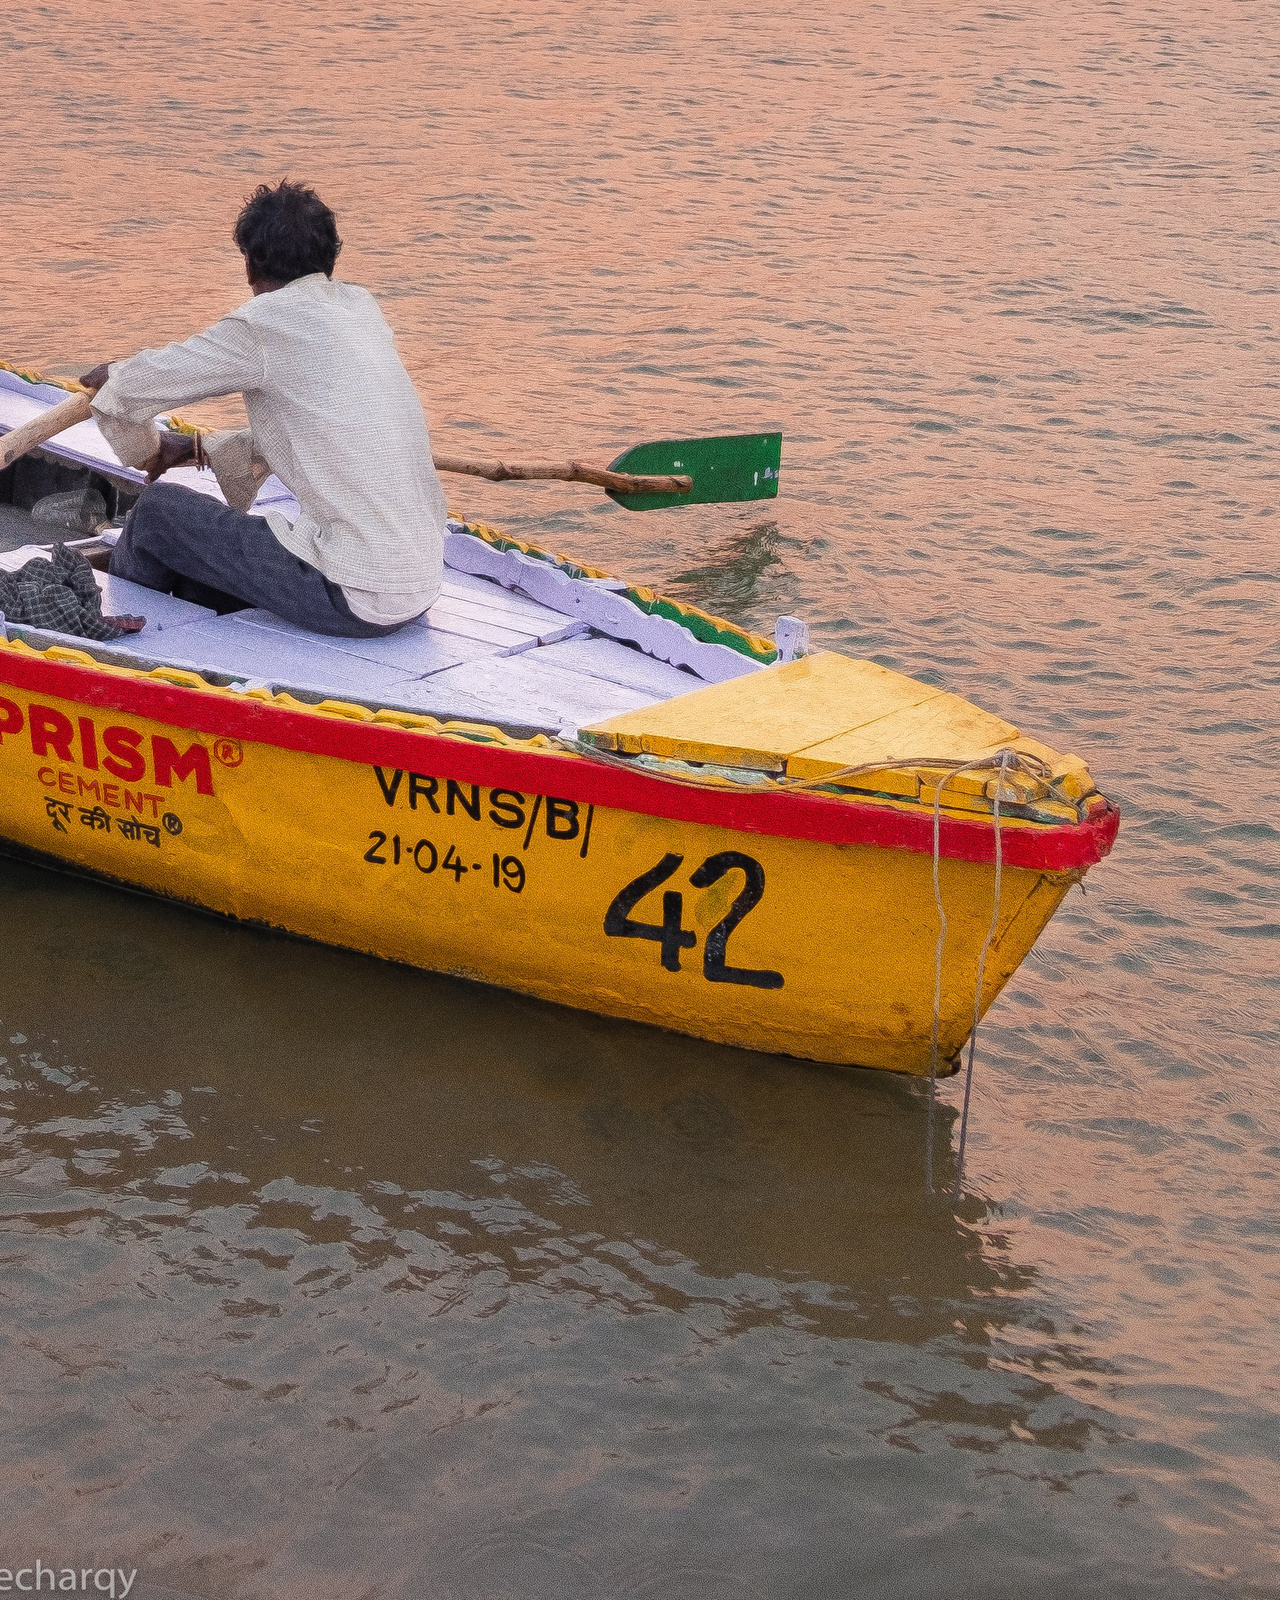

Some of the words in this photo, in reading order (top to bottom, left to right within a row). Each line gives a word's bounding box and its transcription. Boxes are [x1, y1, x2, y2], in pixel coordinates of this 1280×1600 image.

[37, 766, 165, 818] CEMENT
[44, 796, 74, 834] दूर
[78, 806, 111, 833] की
[603, 851, 785, 989] 42
